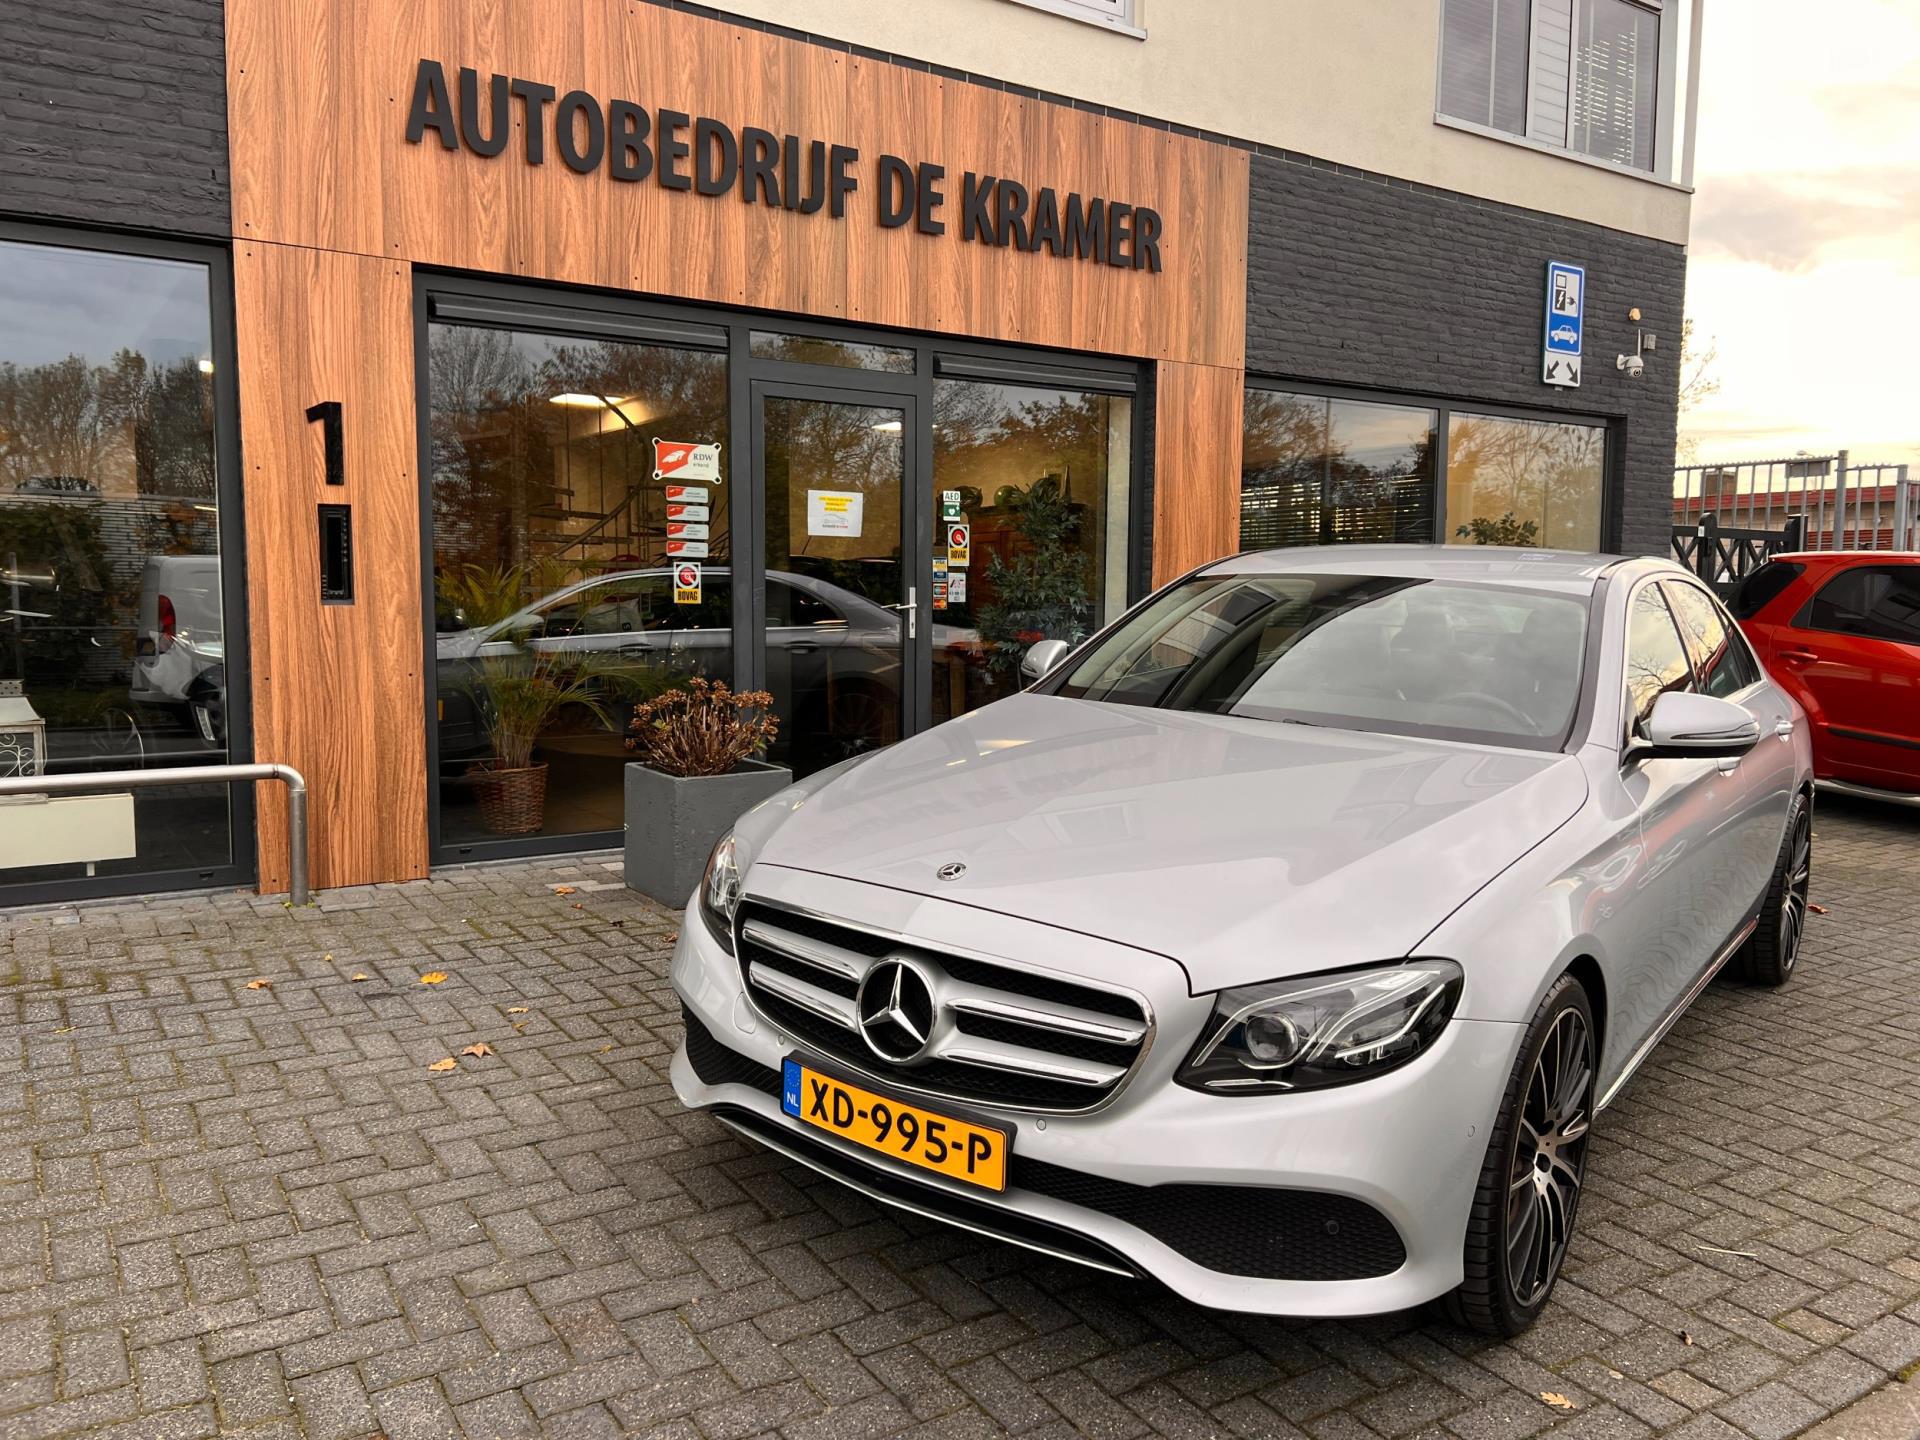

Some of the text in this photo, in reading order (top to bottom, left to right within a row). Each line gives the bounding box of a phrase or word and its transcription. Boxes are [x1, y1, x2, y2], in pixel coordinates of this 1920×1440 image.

[405, 58, 1163, 273] AUTOBEDRIJF DE KRAMER
[305, 401, 345, 486] 1
[693, 453, 713, 462] RDW
[944, 492, 960, 501] AED
[950, 550, 967, 559] BOVAG
[677, 590, 698, 602] BOVAG
[786, 1091, 799, 1108] NL
[810, 1078, 992, 1174] XD-995-P
